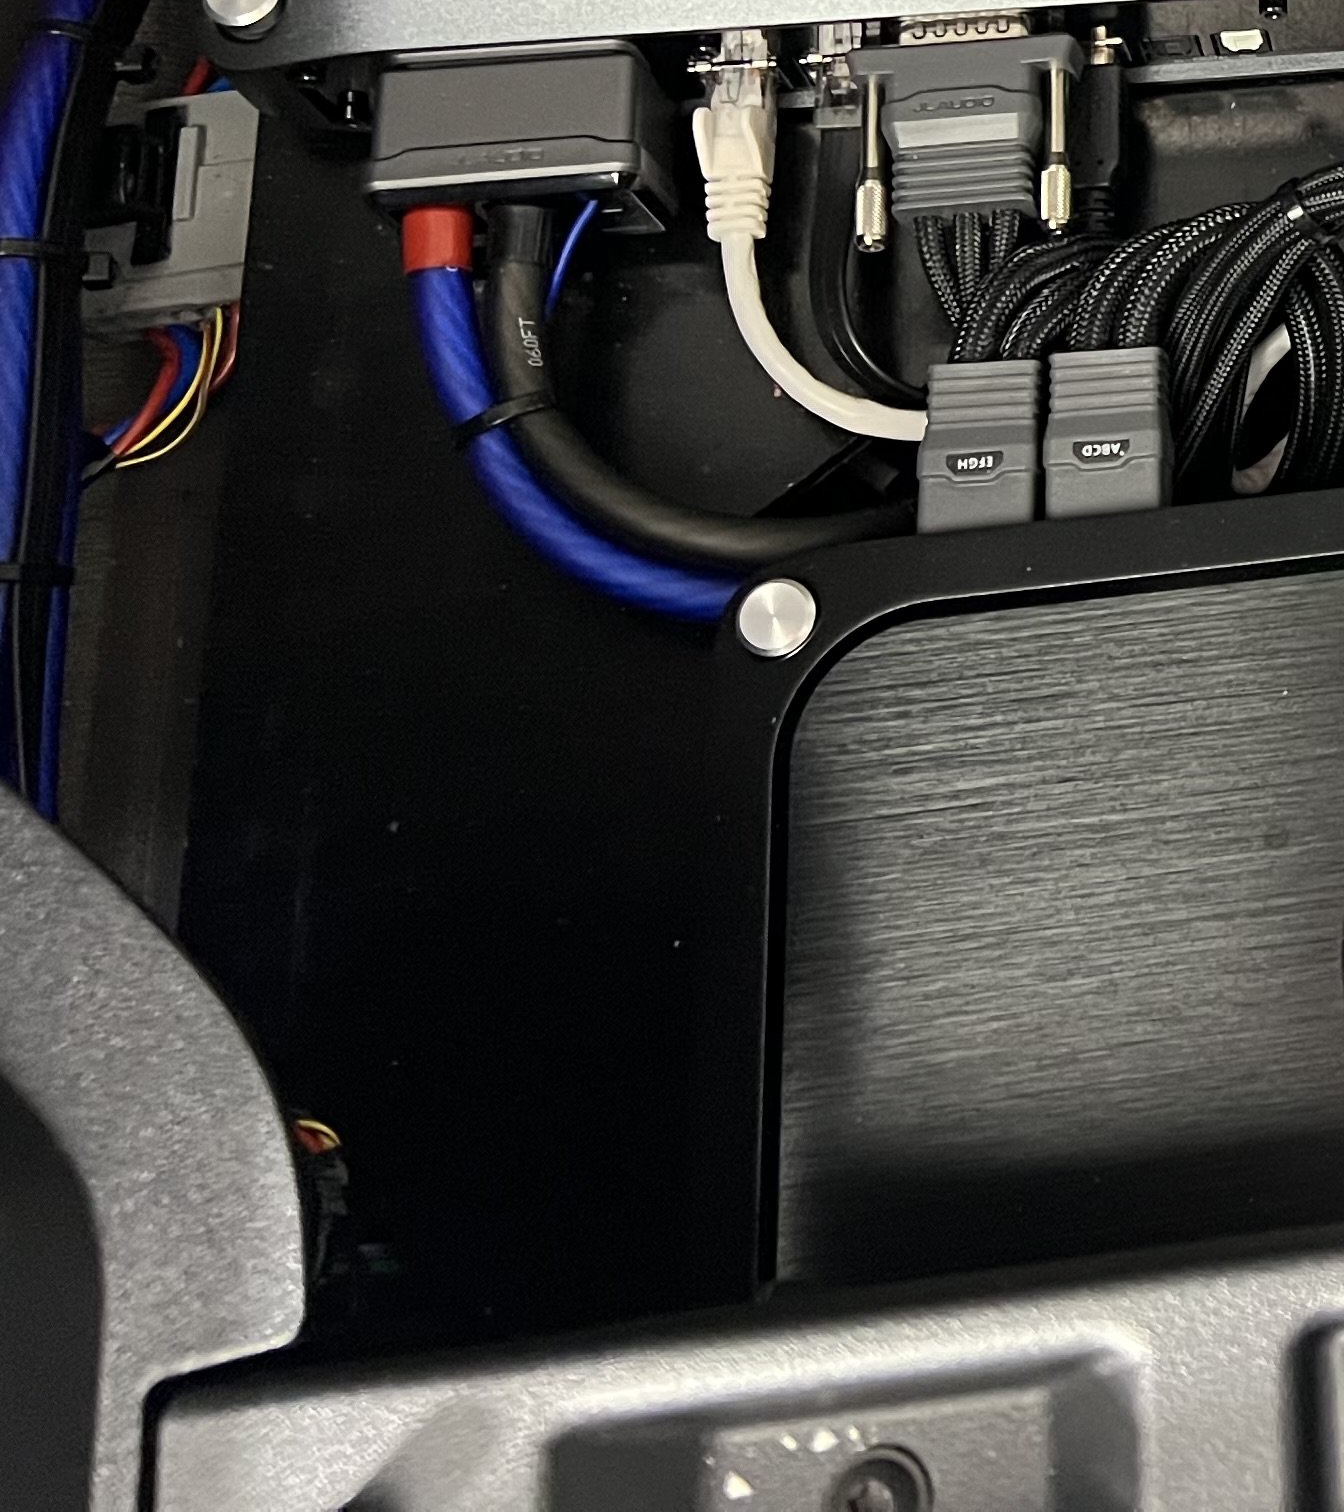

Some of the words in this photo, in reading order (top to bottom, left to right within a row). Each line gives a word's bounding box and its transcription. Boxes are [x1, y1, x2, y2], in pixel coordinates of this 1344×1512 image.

[518, 317, 544, 368] 060FT
[1082, 443, 1121, 457] ABCD
[957, 455, 994, 471] EFGH
